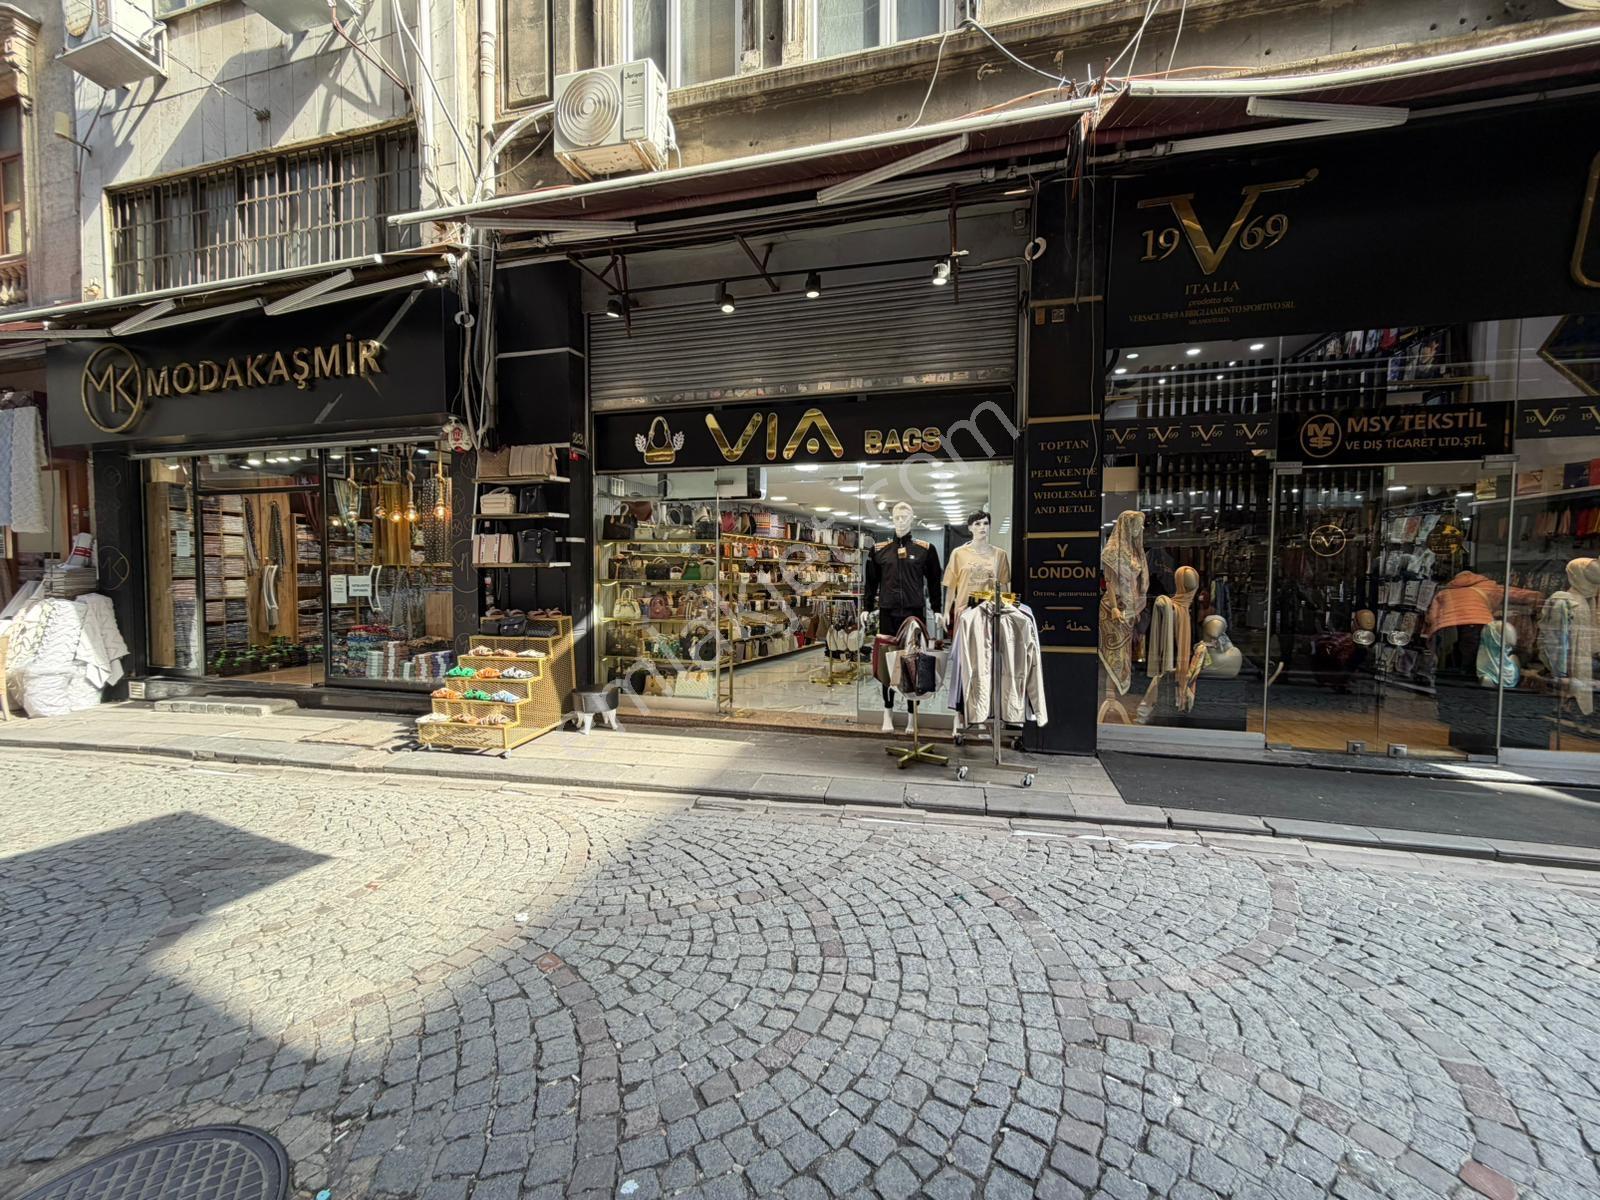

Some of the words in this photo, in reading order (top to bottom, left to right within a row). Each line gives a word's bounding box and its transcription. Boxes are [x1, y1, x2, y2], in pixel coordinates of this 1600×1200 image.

[1185, 280, 1240, 295] ITALIA
[146, 332, 383, 398] MODAKAŞMİR
[1347, 415, 1395, 433] MSY
[1400, 408, 1488, 431] TEKSTİL
[572, 431, 584, 445] 23
[705, 407, 844, 463] VIA
[863, 426, 942, 456] BAGS
[1038, 439, 1089, 451] TOPTAN
[1345, 440, 1360, 450] VE
[1363, 439, 1383, 451] DIŞ
[1385, 437, 1436, 449] TİCARET
[1056, 455, 1071, 464] VE
[1030, 467, 1098, 479] PERAKENDE
[1033, 489, 1097, 500] WHOLESALE
[1034, 505, 1056, 514] AND
[1058, 504, 1095, 513] RETAIL
[1057, 543, 1069, 559] Y
[1029, 566, 1096, 579] LONDON
